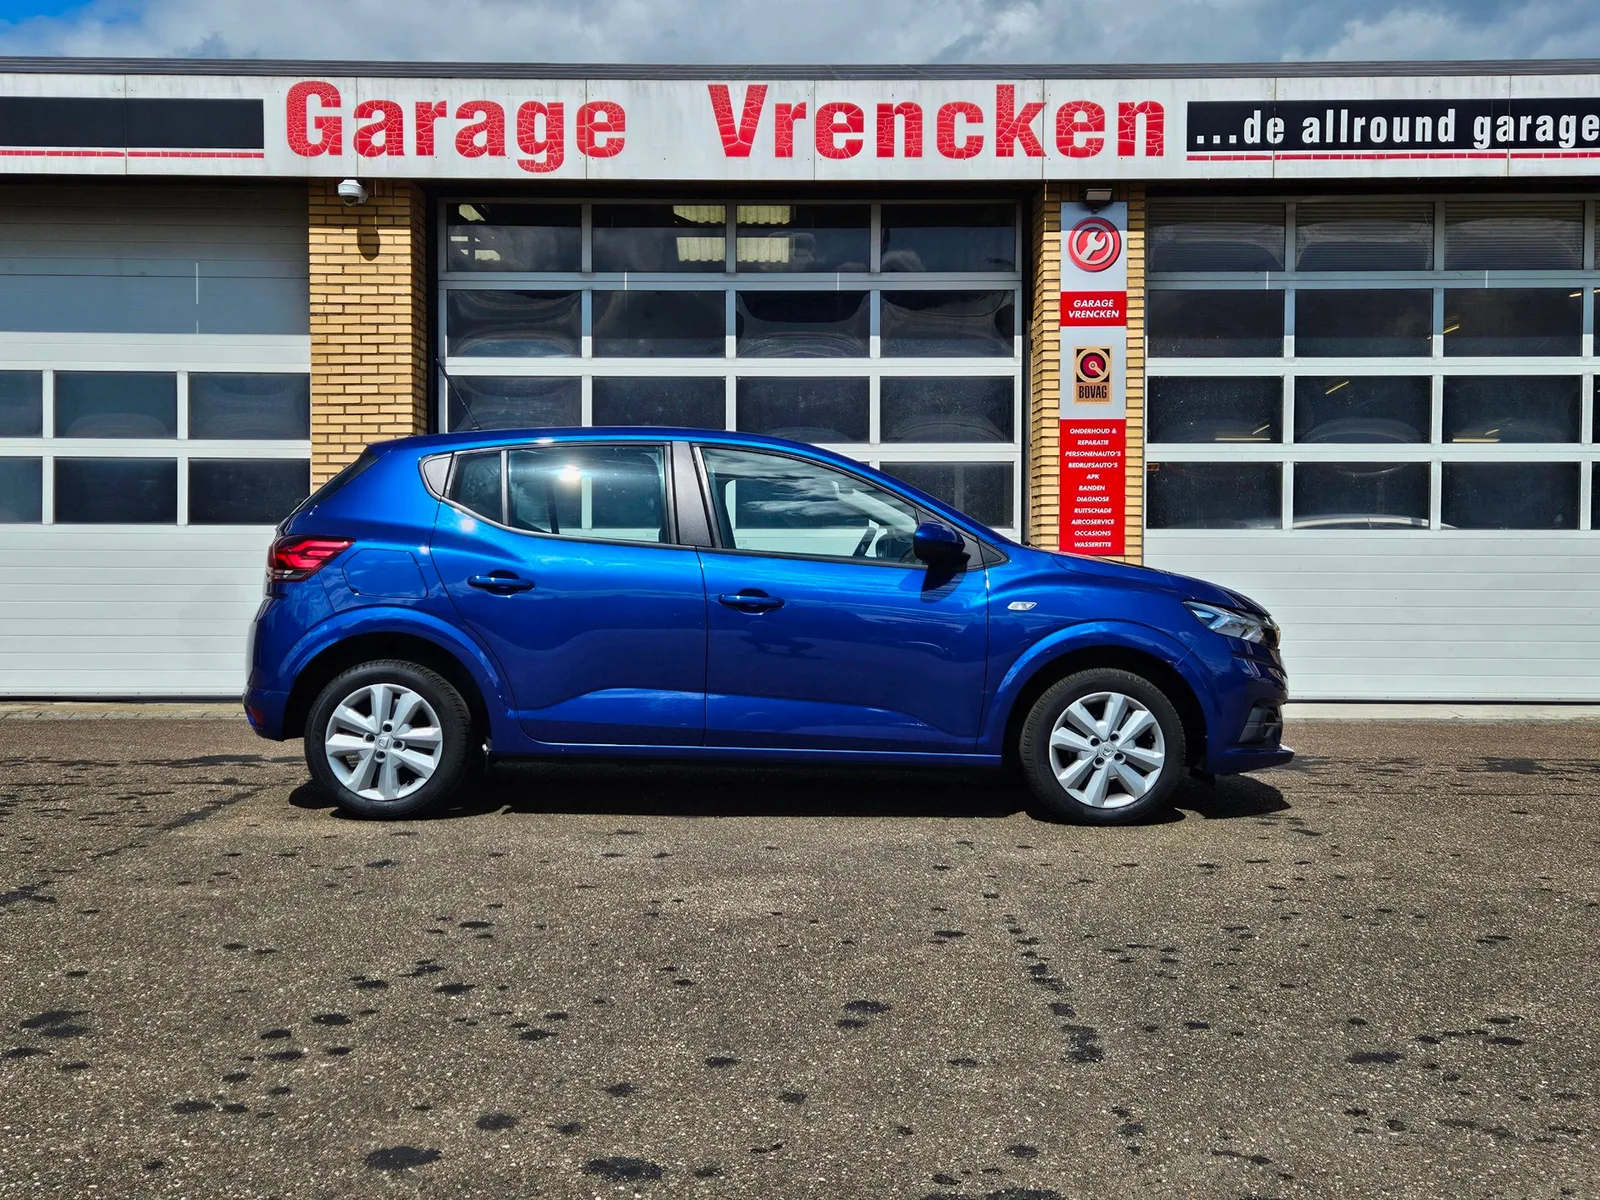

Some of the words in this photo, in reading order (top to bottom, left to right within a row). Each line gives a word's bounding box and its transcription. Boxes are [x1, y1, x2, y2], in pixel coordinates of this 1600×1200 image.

[286, 80, 626, 173] Garage
[707, 84, 1165, 160] Vrencken
[1302, 108, 1456, 143] allround
[1473, 113, 1600, 149] garage
[1073, 299, 1114, 308] GARAGE
[1068, 310, 1119, 318] VRENCKEN
[1079, 385, 1107, 399] BOVAG
